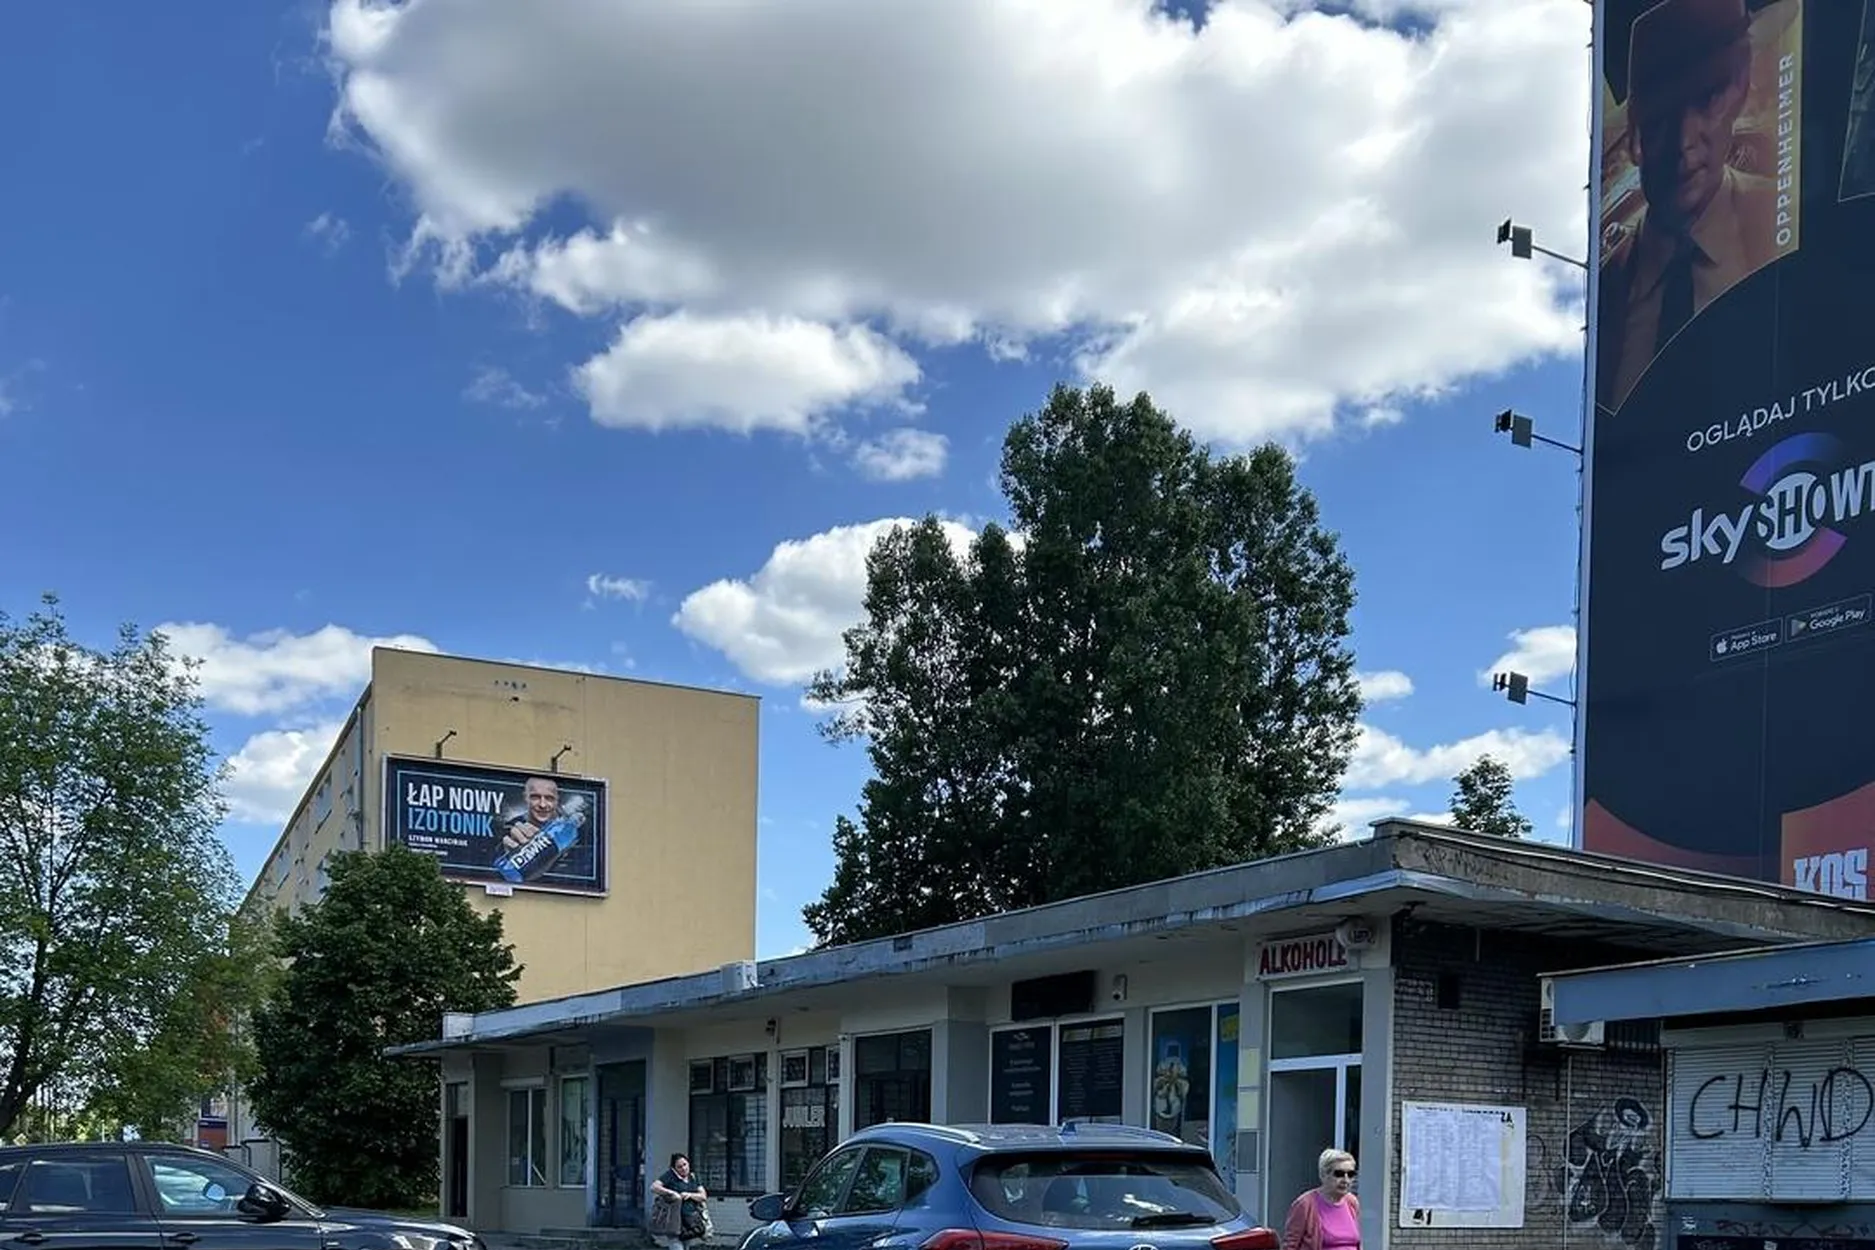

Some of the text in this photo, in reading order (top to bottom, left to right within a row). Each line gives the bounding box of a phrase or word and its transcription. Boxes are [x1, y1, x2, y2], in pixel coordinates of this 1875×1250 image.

[1776, 53, 1793, 246] OPPENHEIMER
[1686, 397, 1796, 452] OGLĄDAJ
[1809, 614, 1844, 630] Google
[1845, 609, 1866, 623] Play
[1730, 639, 1750, 652] App
[1751, 632, 1777, 646] Store
[407, 781, 504, 814] ŁAP NOWY
[408, 807, 494, 838] IZOTONIK
